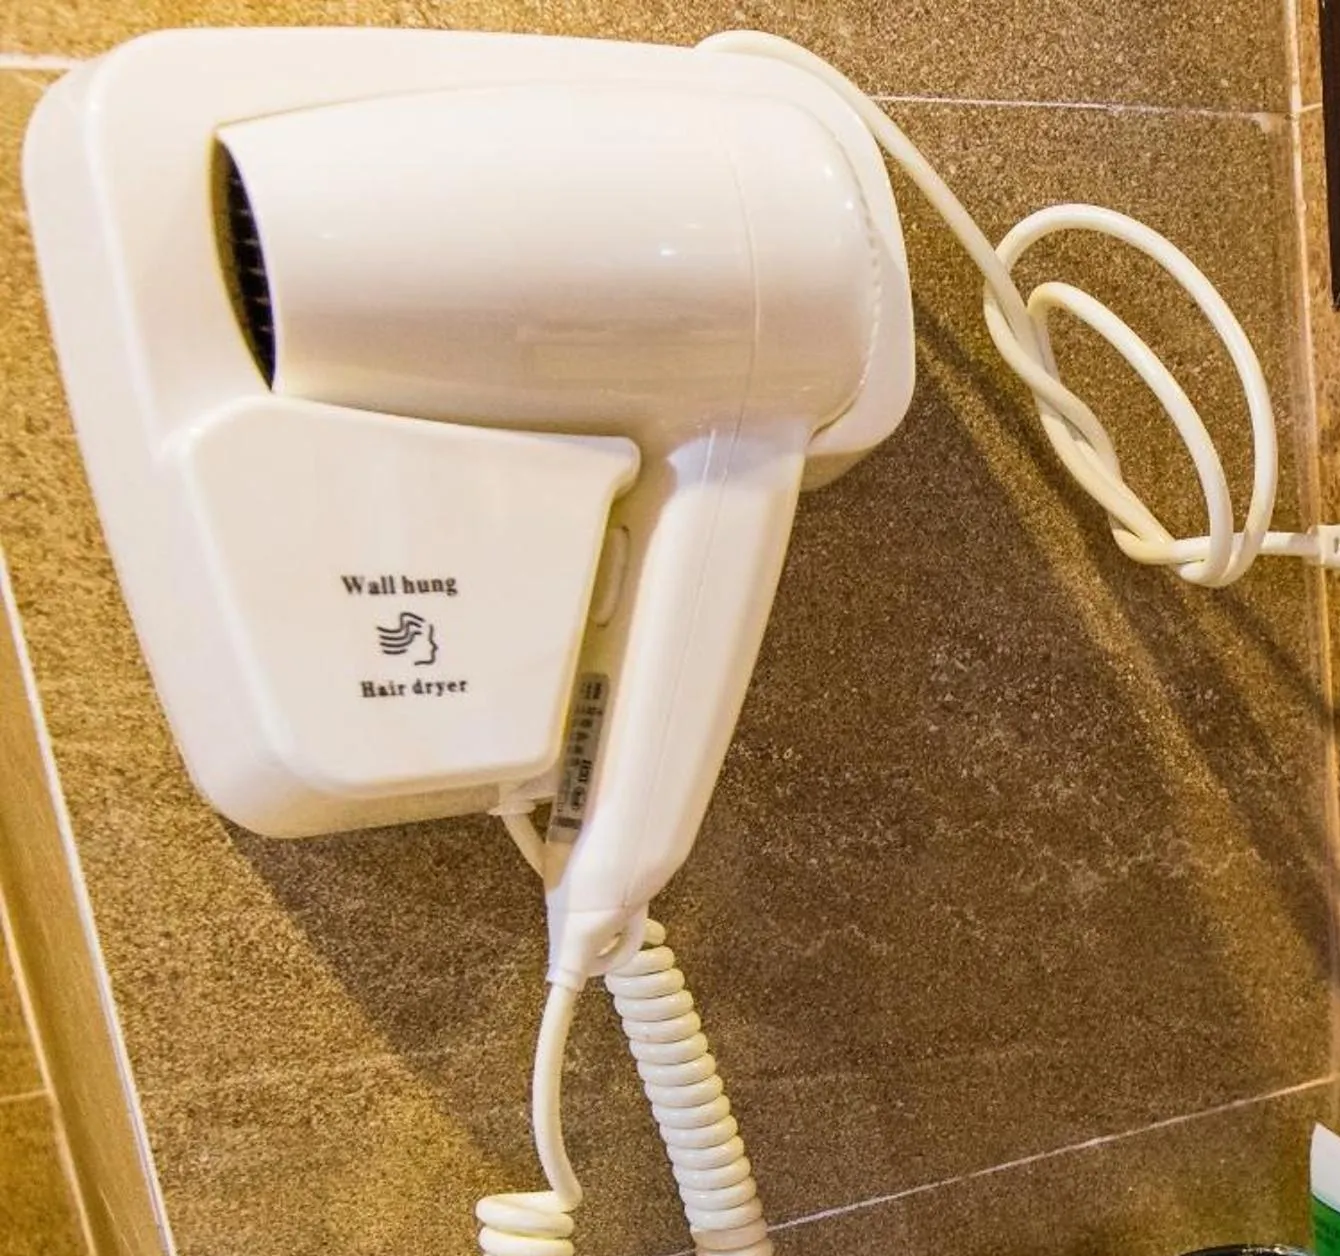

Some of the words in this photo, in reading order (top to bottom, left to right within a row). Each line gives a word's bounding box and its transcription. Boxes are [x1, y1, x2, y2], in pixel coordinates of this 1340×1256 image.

[341, 575, 396, 595] Wall
[401, 575, 458, 596] hung
[361, 680, 406, 698] Hair
[411, 678, 468, 697] dryer
